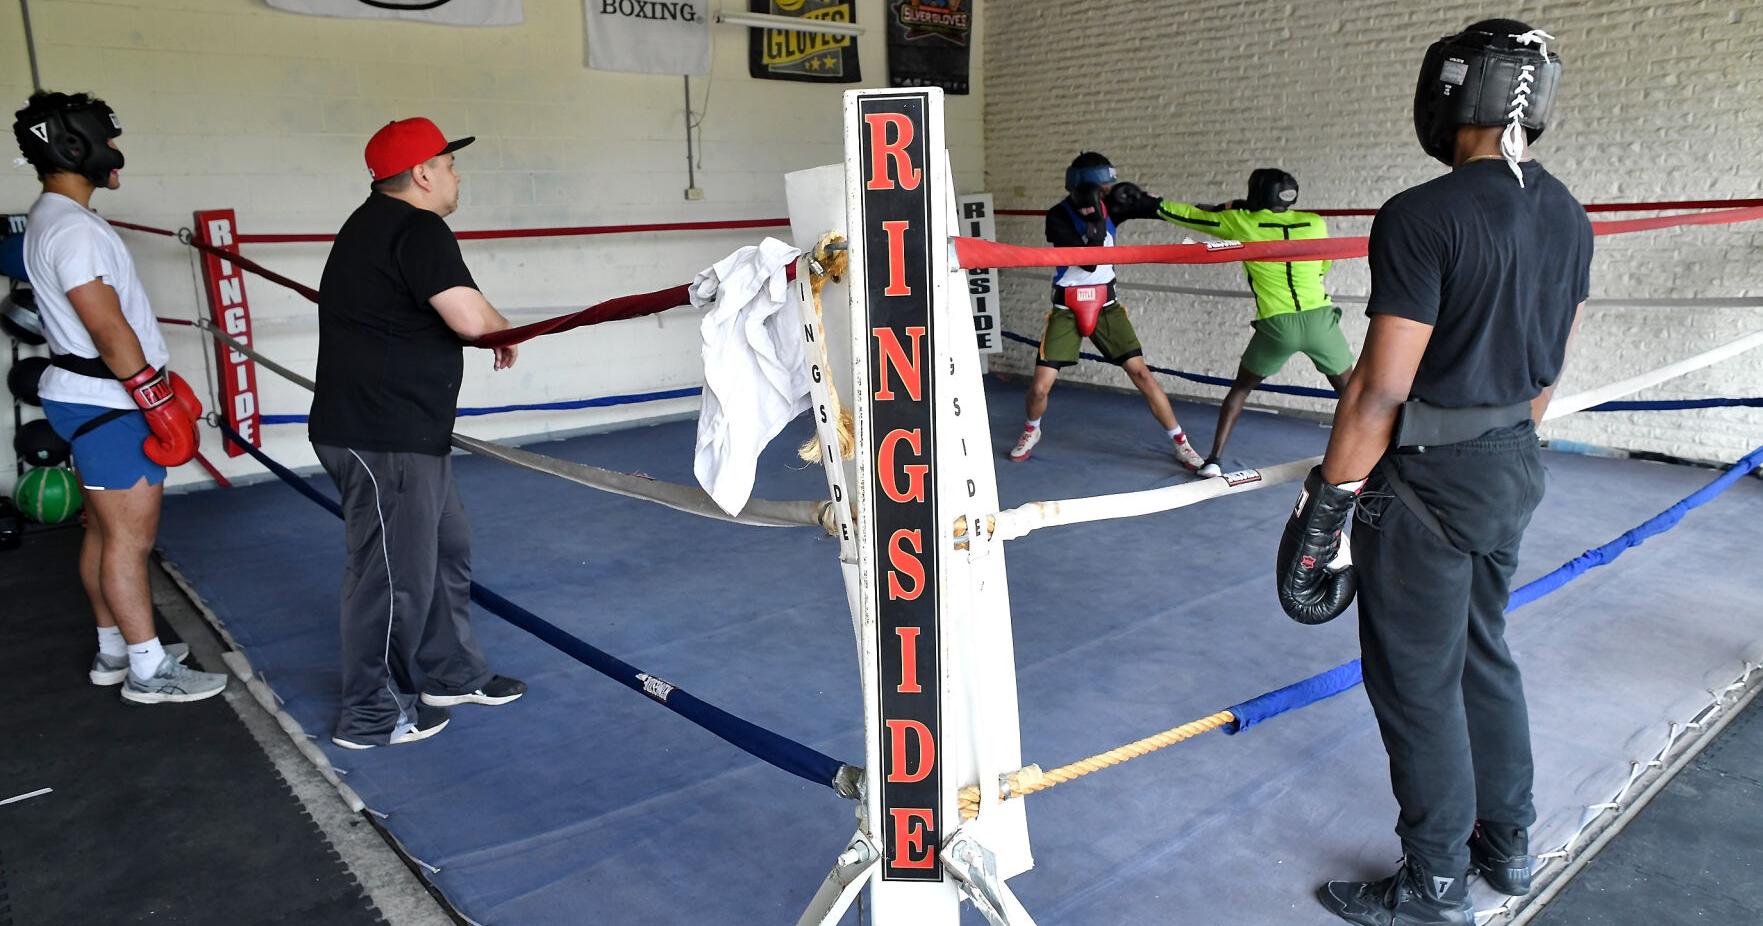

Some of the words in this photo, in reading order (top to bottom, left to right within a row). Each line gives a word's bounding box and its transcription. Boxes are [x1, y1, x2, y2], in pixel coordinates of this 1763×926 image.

[600, 0, 696, 22] BOXING
[963, 202, 994, 349] RISIDE
[800, 282, 850, 541] INGSIDE
[864, 112, 936, 869] RINGSIDE
